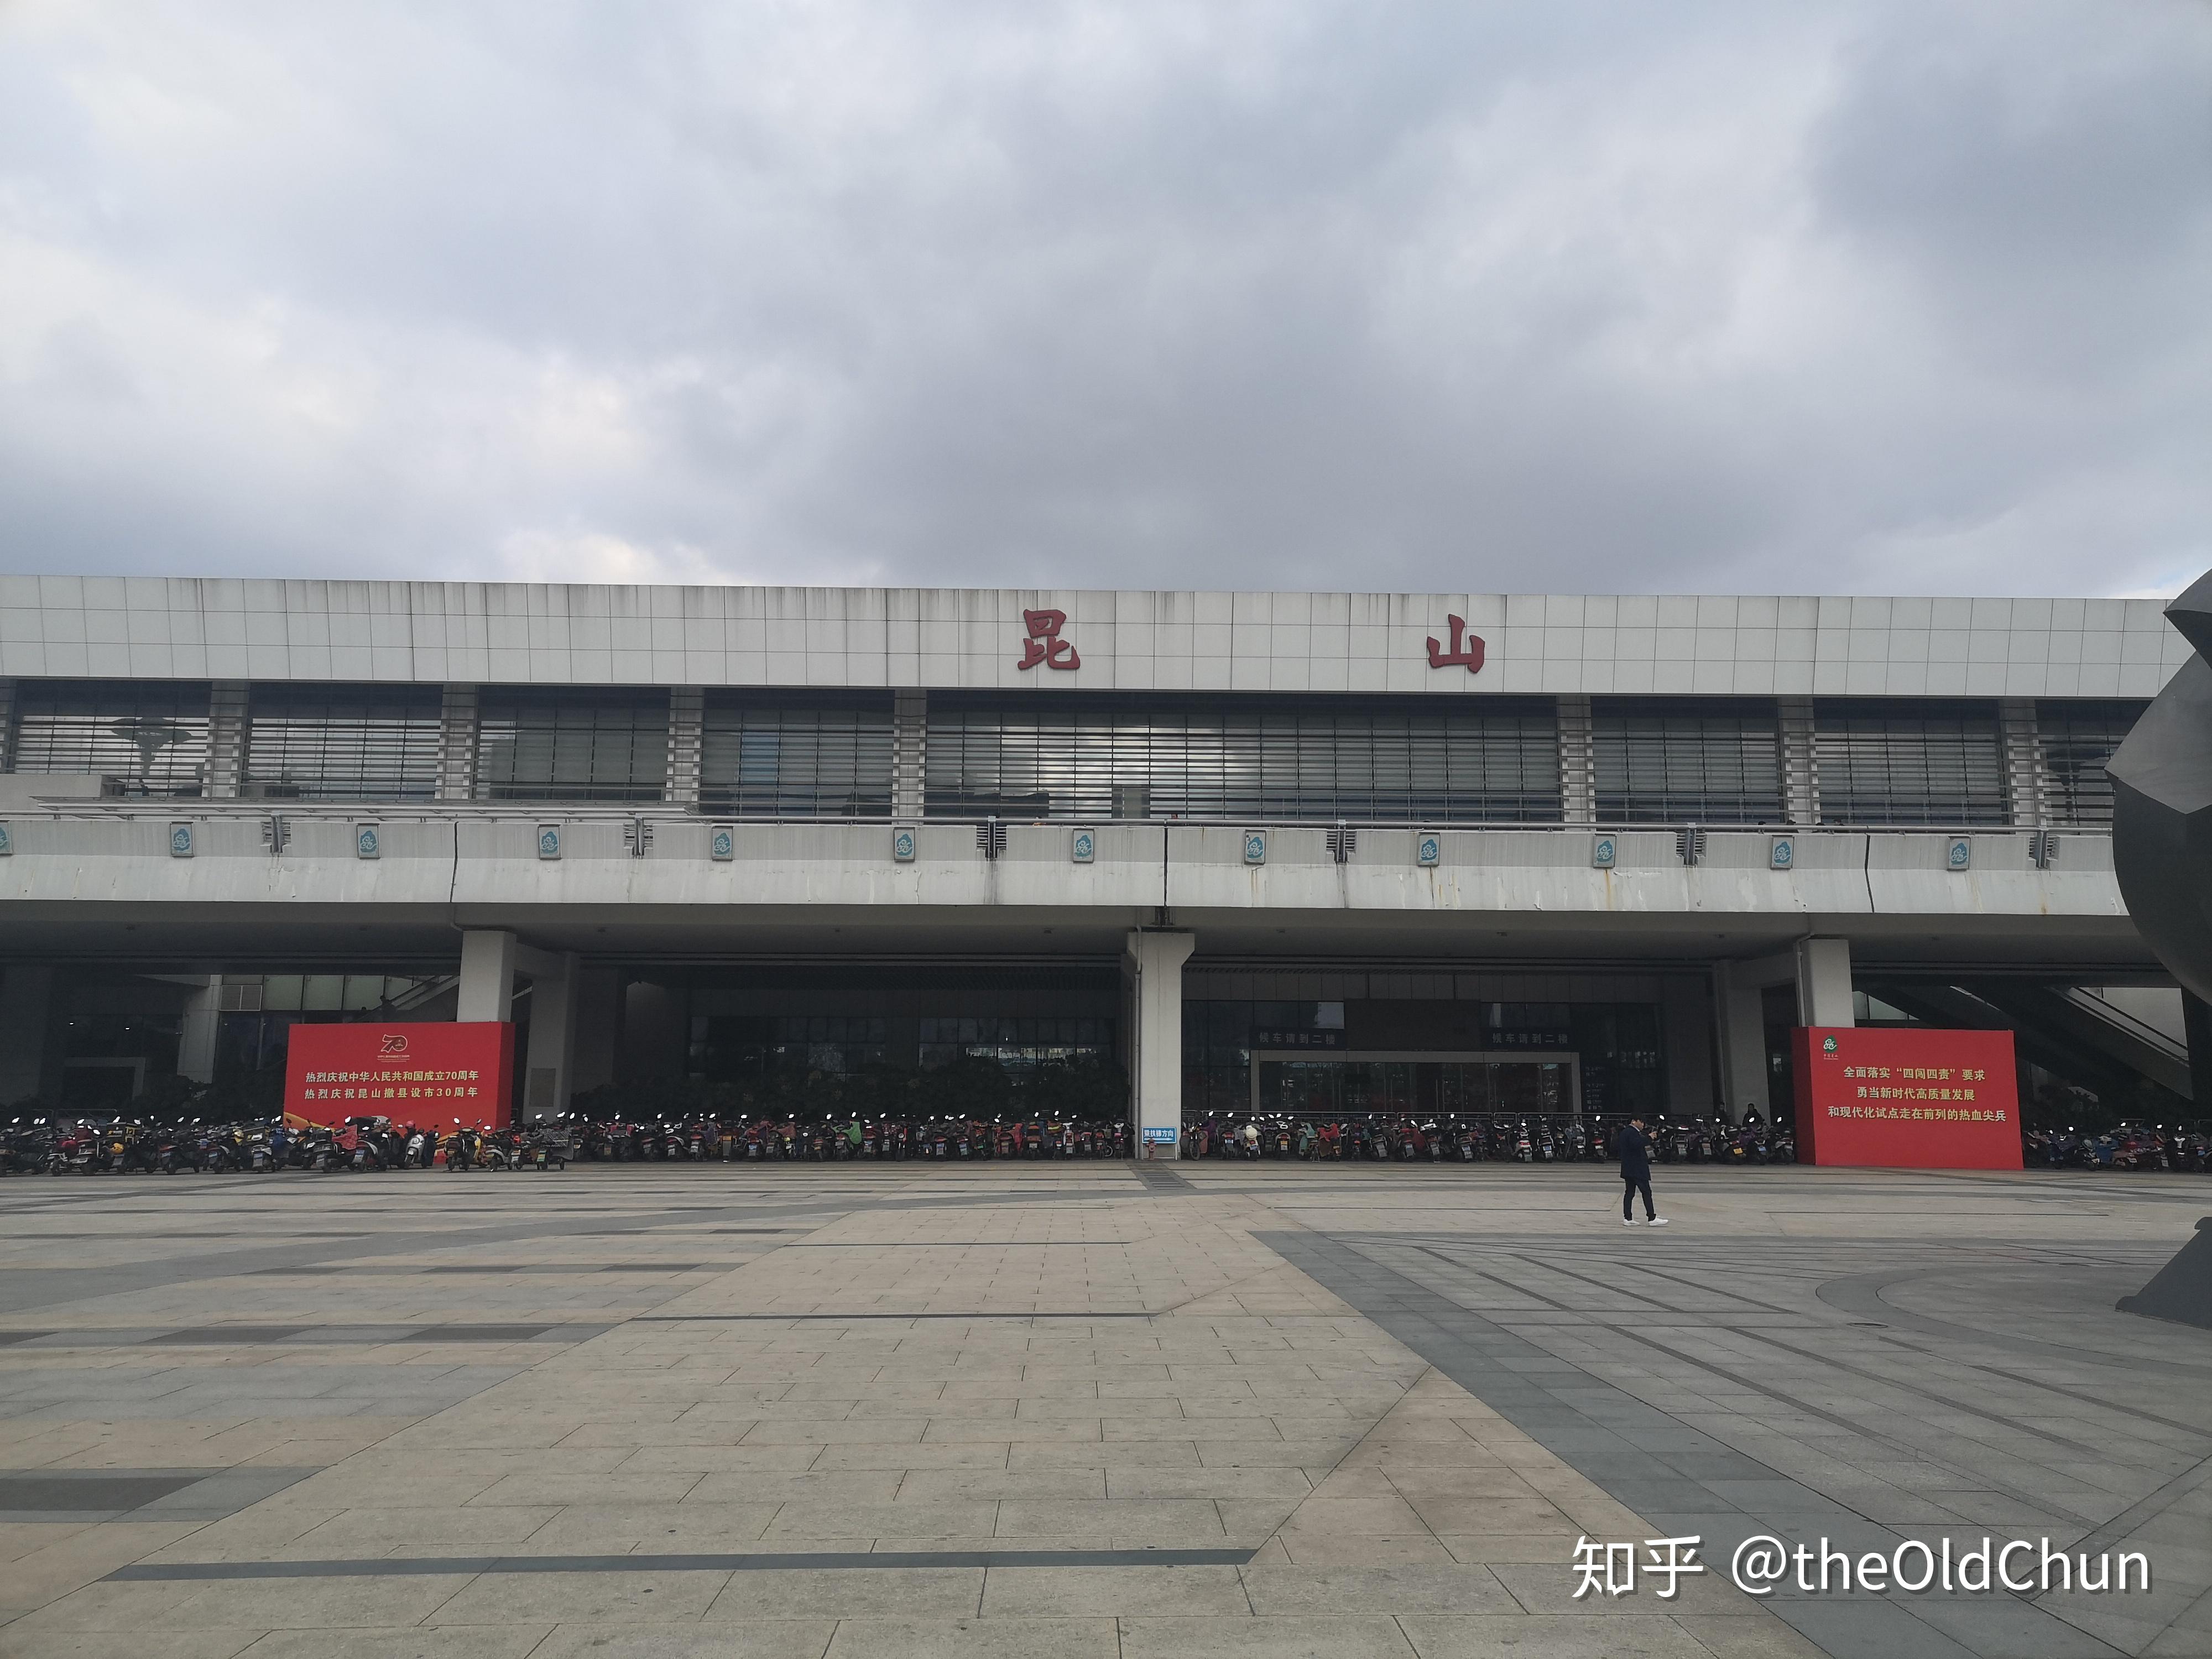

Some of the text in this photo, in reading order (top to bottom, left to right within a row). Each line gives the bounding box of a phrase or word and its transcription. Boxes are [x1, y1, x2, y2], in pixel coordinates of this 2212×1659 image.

[305, 1071, 479, 1082] 热烈庆祝中华人民共和国成立70周年
[304, 1087, 478, 1099] 热烈庆祝昆山撤县设市30周年
[1856, 1086, 1975, 1101] 勇当新时代高质量发展
[1828, 1105, 2007, 1122] 和现代化试点走在前列的热血尖兵
